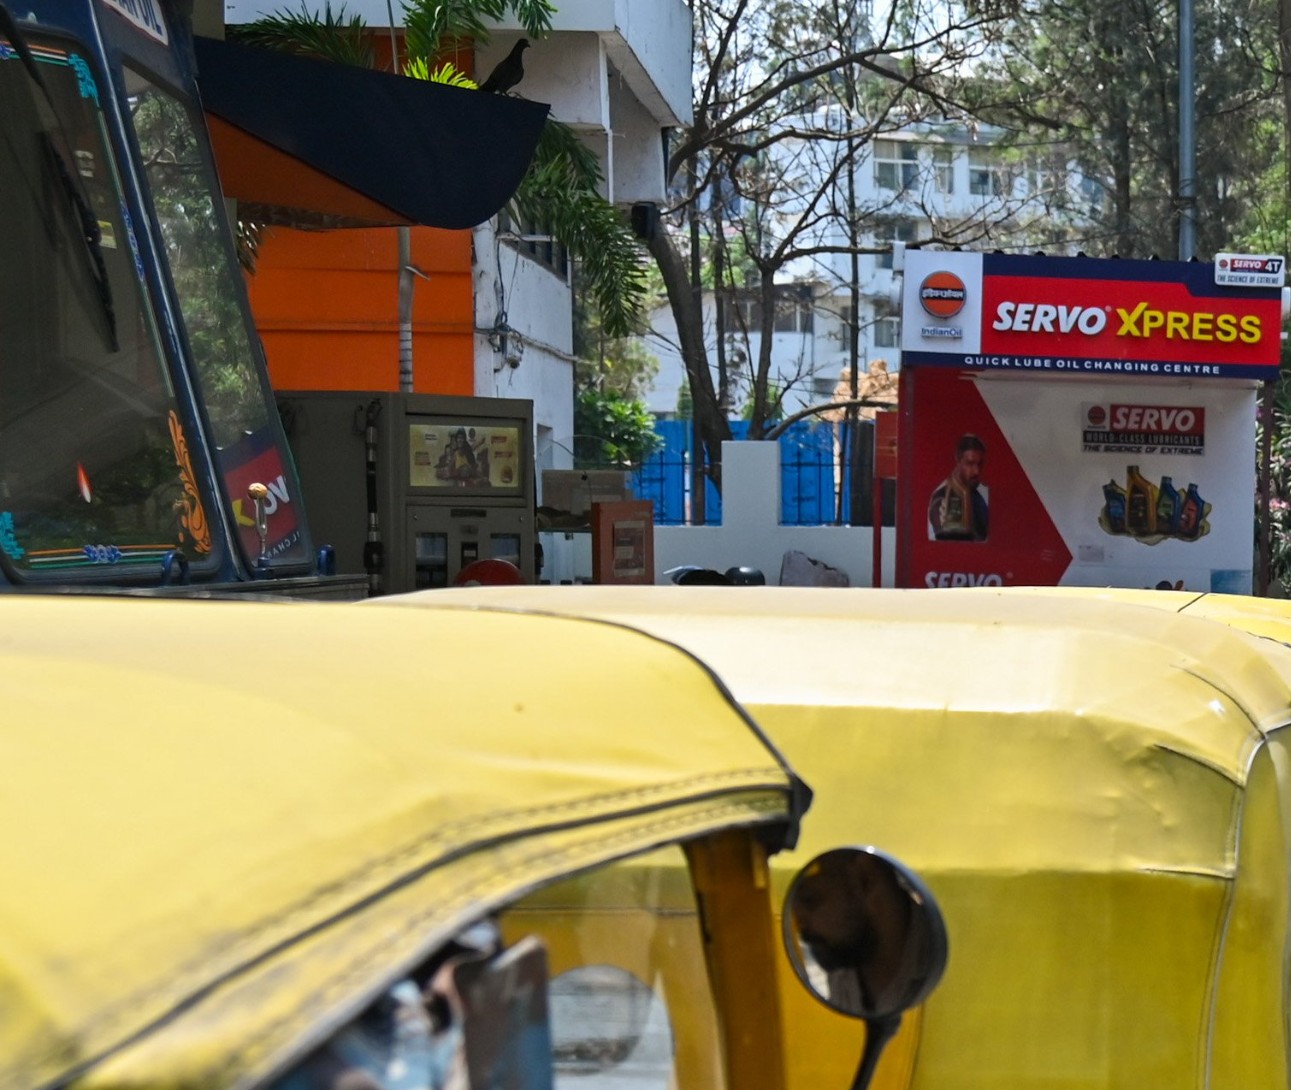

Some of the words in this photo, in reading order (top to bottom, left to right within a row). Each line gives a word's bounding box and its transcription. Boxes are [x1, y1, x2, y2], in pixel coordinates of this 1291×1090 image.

[1233, 260, 1262, 269] SERVO
[1265, 261, 1281, 273] 4T
[1228, 275, 1248, 283] SCIENCE
[993, 301, 1106, 335] SERVO
[1116, 302, 1262, 343] XPRESS
[921, 327, 962, 337] IndianOil
[965, 356, 1009, 366] QUICK
[1015, 358, 1050, 367] LUBE
[1056, 360, 1079, 369] OIL
[1084, 361, 1159, 372] CHANGING
[1164, 364, 1220, 375] CENTRE
[1113, 407, 1195, 431] SERVO
